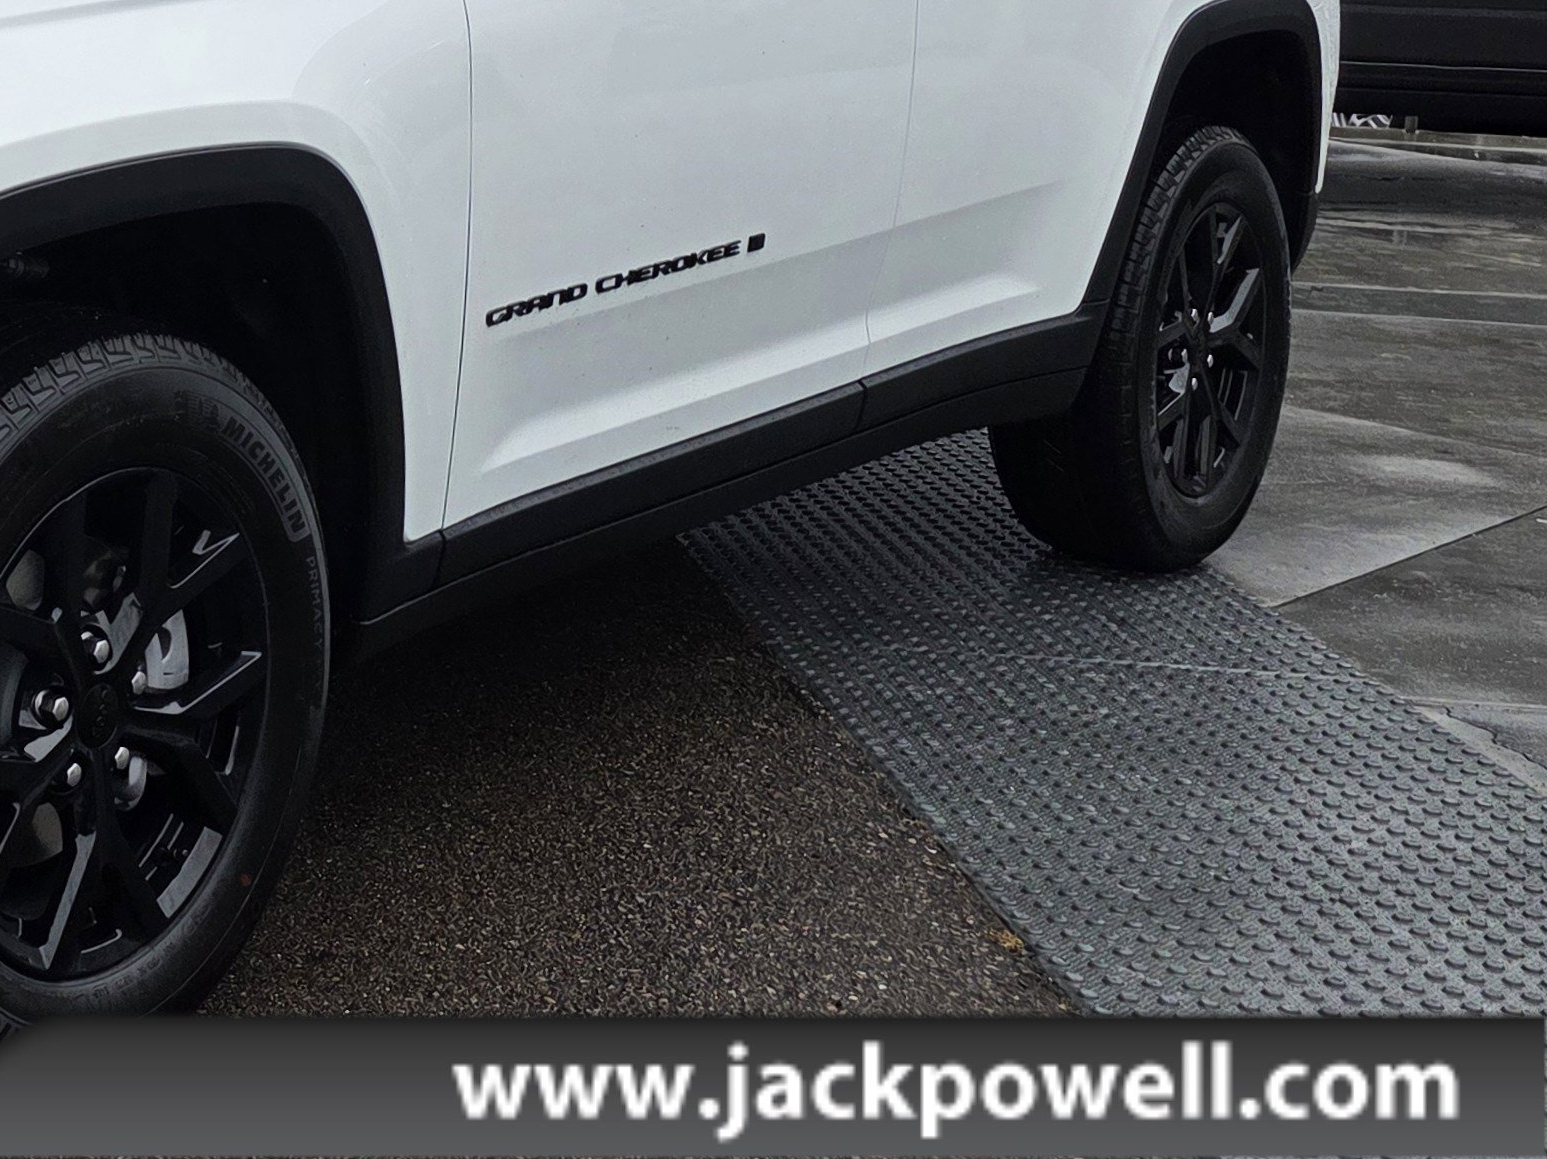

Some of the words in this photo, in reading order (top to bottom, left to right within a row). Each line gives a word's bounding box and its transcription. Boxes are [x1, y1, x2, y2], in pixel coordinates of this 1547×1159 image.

[485, 282, 588, 328] GRAND
[594, 239, 742, 294] CHEROKEE
[221, 415, 306, 534] MICHELIN
[305, 555, 324, 652] PRIMACY
